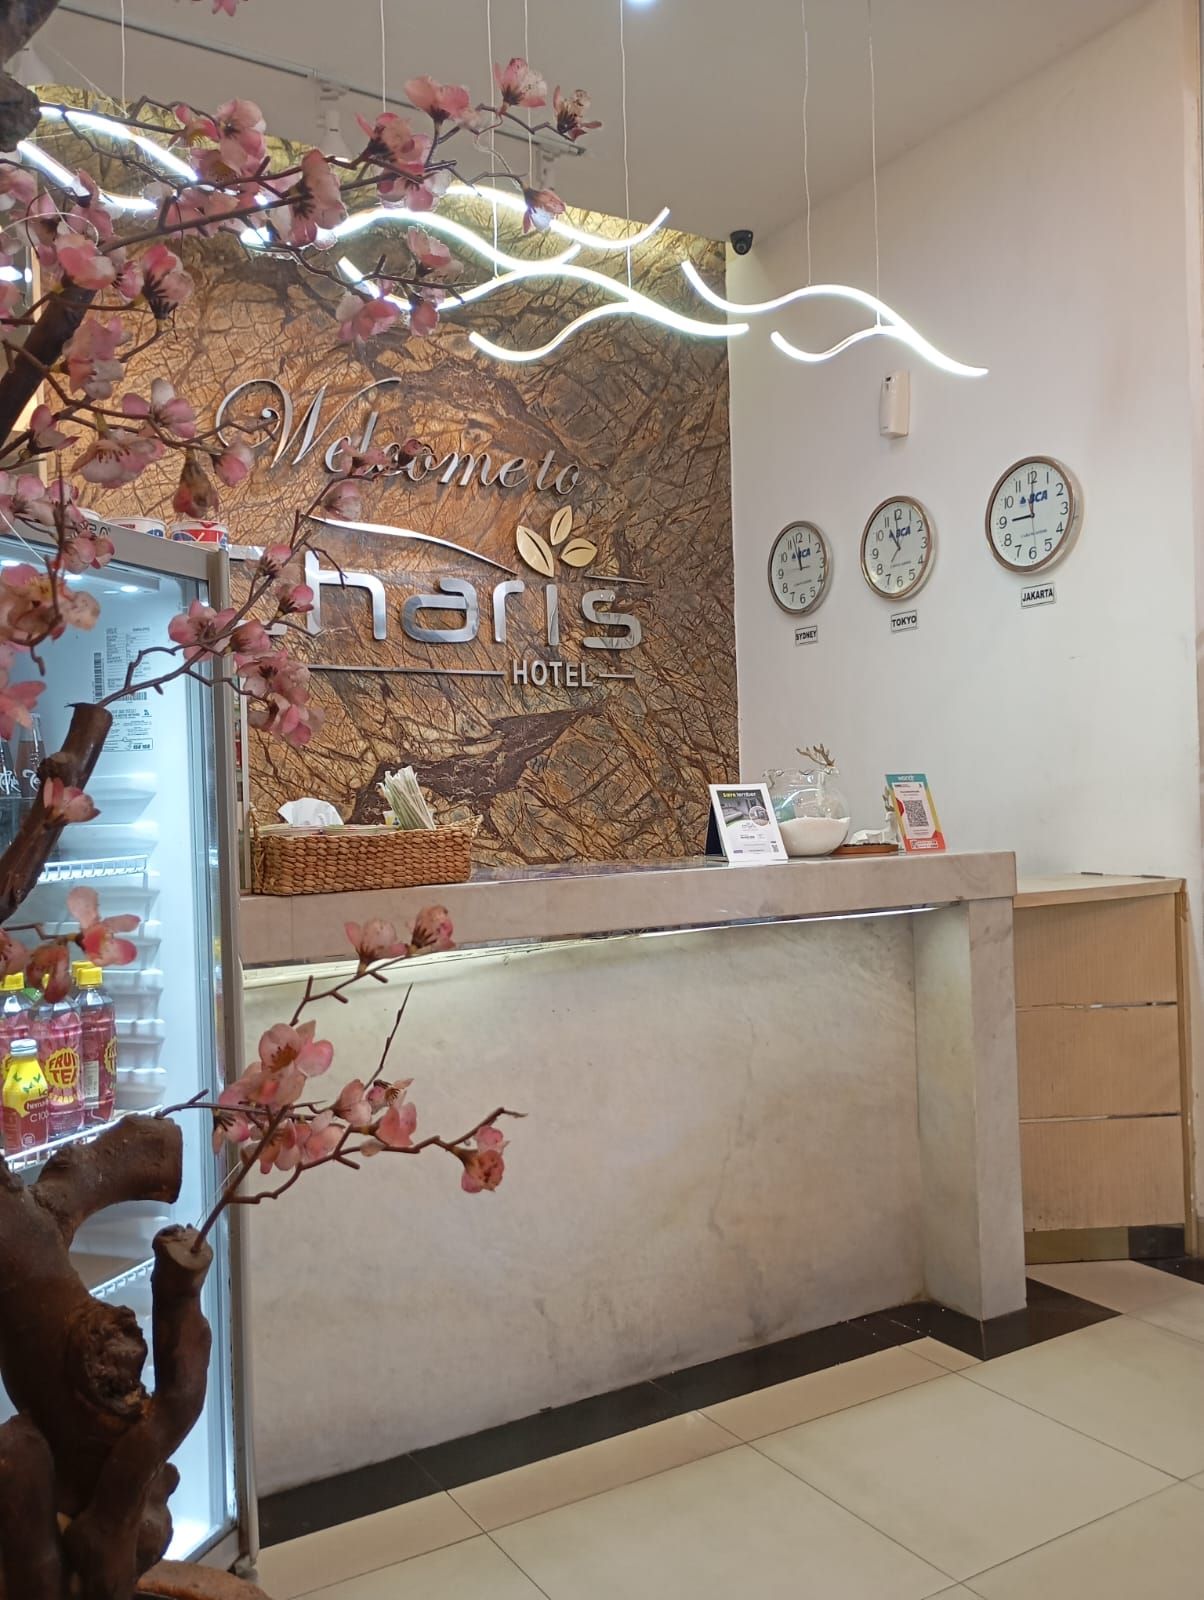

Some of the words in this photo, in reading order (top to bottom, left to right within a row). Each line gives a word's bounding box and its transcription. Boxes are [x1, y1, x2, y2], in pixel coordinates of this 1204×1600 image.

[215, 377, 528, 488] Welcome
[537, 450, 585, 495] to
[1027, 470, 1038, 484] 12
[1045, 471, 1050, 485] 1
[1015, 480, 1022, 493] 11
[1055, 482, 1064, 497] 2
[1004, 495, 1014, 509] 10
[1060, 501, 1068, 516] 3
[884, 517, 890, 528] 11
[916, 520, 923, 532] 2
[998, 516, 1008, 529] 9
[1055, 521, 1064, 535] 4
[876, 529, 884, 542] 10
[1003, 533, 1012, 547] 8
[815, 543, 821, 553] 2
[920, 537, 927, 549] 3
[1044, 538, 1053, 552] 5
[780, 552, 788, 563] 10
[872, 548, 879, 560] 9
[1014, 544, 1022, 558] 7
[1028, 546, 1037, 560] 6
[819, 558, 825, 569] 3
[917, 554, 924, 564] 4
[778, 569, 784, 579] 9
[877, 563, 883, 575] 8
[908, 568, 915, 581] 5
[885, 573, 891, 585] 7
[896, 575, 904, 588] 6
[782, 583, 788, 593] 8
[810, 586, 816, 598] 5
[232, 550, 642, 650] haris
[789, 591, 795, 603] 7
[799, 593, 806, 604] 6
[1022, 588, 1054, 602] JAKARTA
[891, 615, 917, 628] TOKYO
[795, 630, 817, 641] SYDNEY
[512, 659, 593, 687] HOTEL
